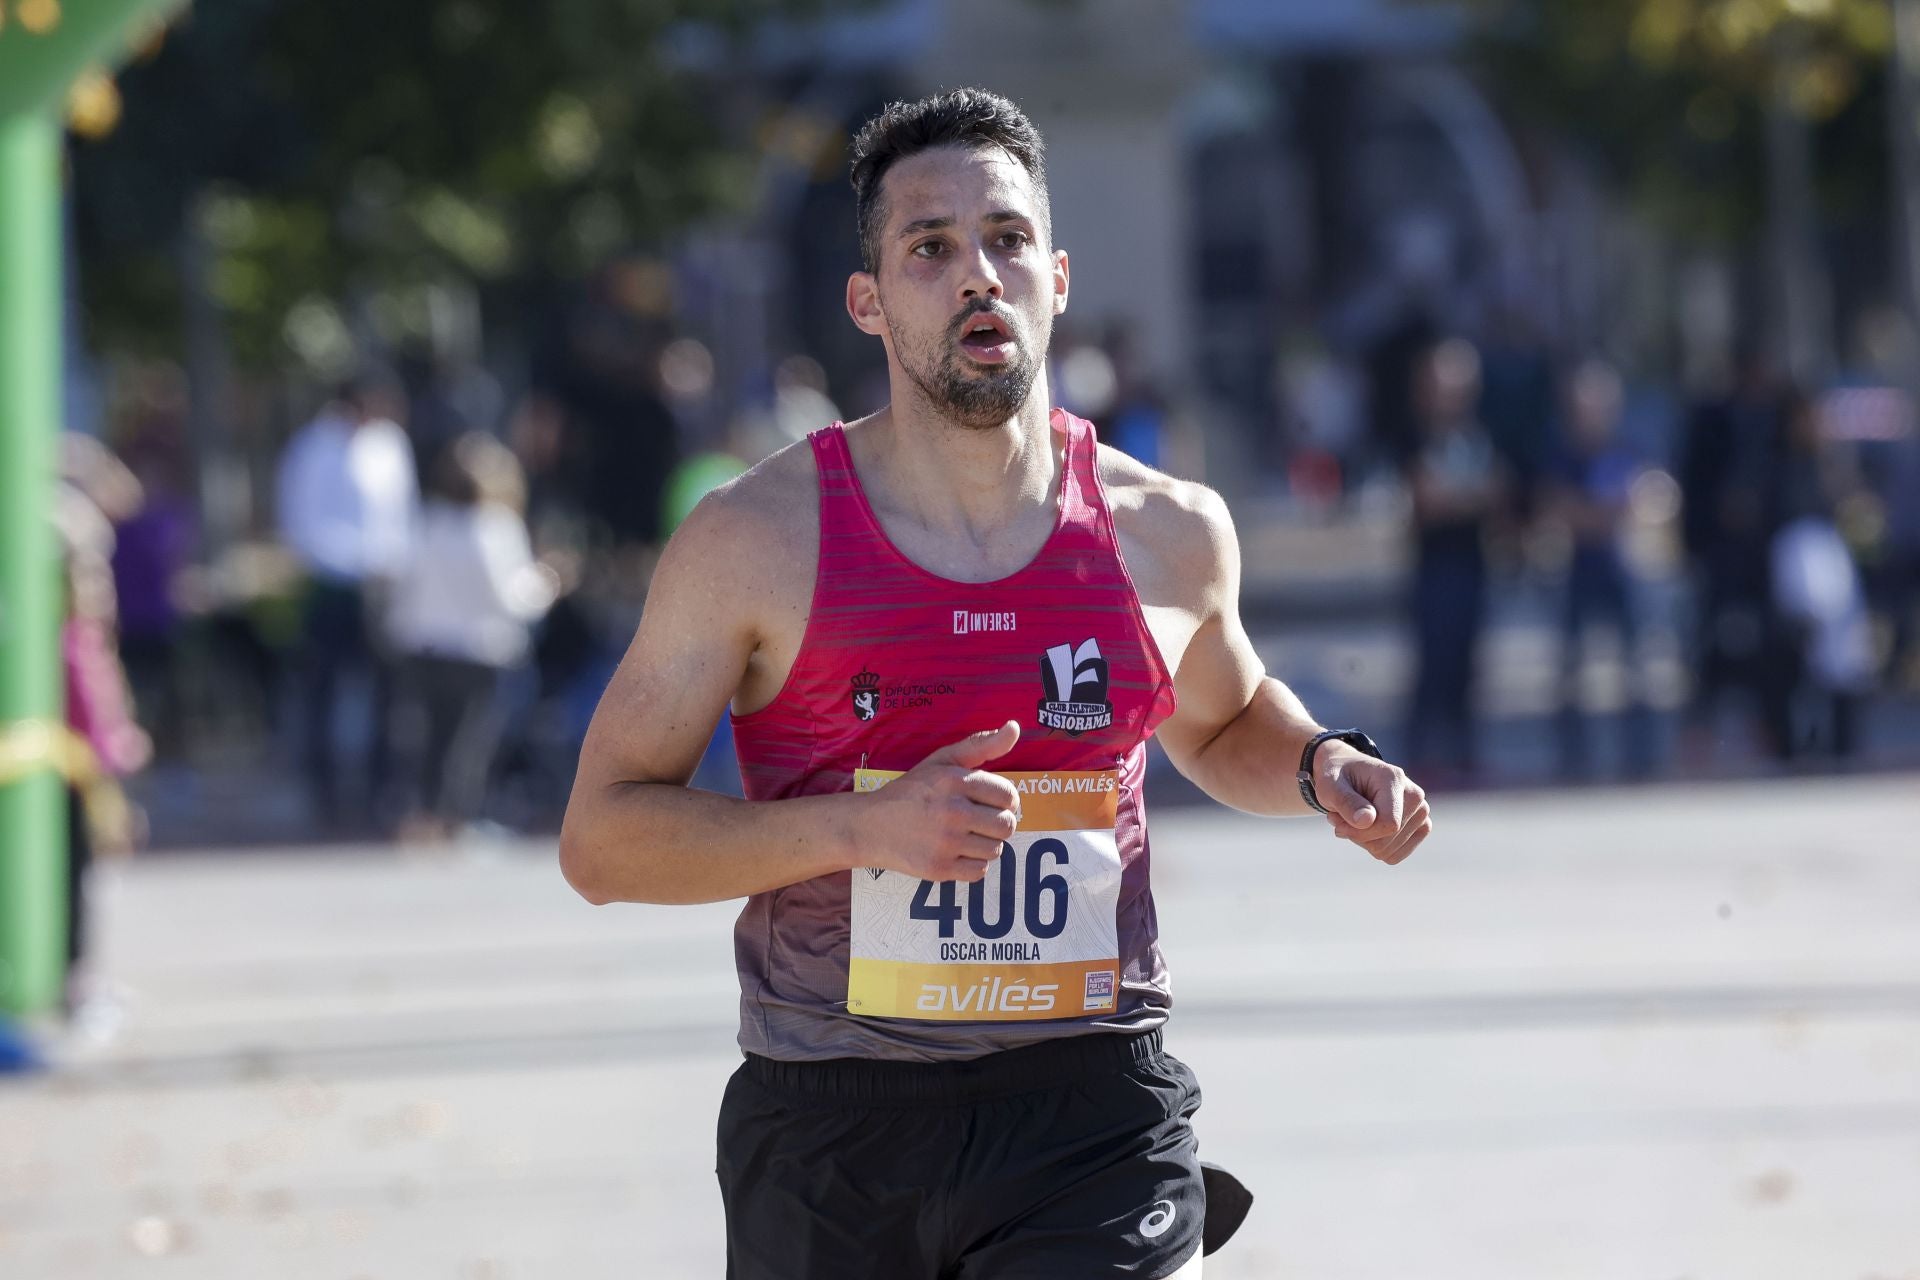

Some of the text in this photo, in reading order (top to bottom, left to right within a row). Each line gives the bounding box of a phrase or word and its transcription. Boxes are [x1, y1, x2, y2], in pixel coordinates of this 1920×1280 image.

[970, 612, 1016, 631] INVERSE
[885, 680, 955, 697] DIPUTACIÓN
[884, 699, 898, 709] DE
[1048, 703, 1105, 714] CLUB ATLETISMO
[1038, 709, 1111, 731] FISIORAMA
[1015, 774, 1062, 794] ATÓN
[1064, 774, 1113, 793] AVILÉS
[910, 837, 1069, 939] 406
[940, 942, 1040, 961] OSCAR MORLA
[917, 976, 1059, 1012] avilés
